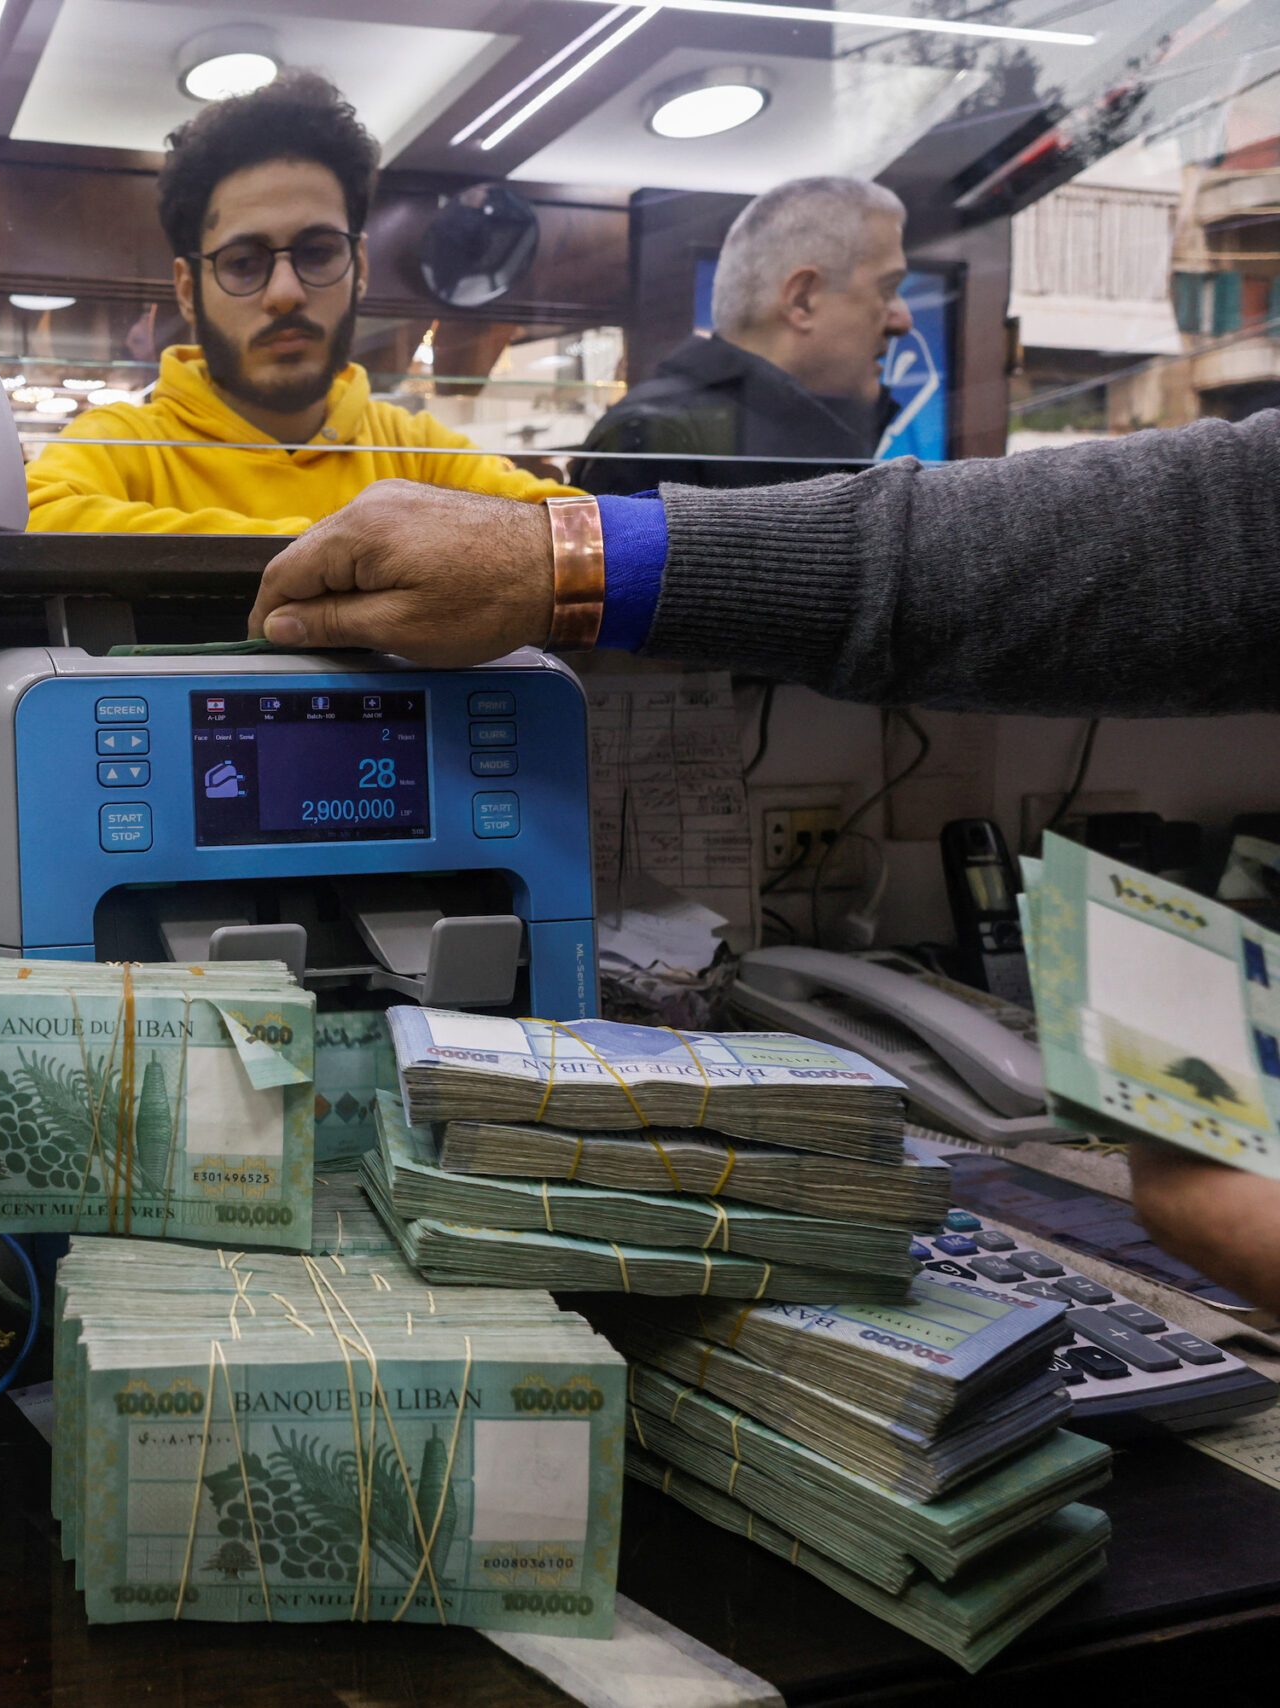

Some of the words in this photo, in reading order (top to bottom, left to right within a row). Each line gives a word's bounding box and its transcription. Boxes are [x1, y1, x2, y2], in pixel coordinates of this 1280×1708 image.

[99, 705, 145, 716] SCREEN
[382, 728, 391, 742] 2
[480, 760, 511, 769] MODE
[358, 757, 397, 788] 28
[302, 799, 395, 824] 2,900,000
[480, 803, 512, 813] START
[108, 813, 143, 824] START
[483, 821, 510, 830] STOP
[111, 832, 141, 842] STOP
[90, 1019, 116, 1034] DU
[522, 1057, 602, 1077] LIBAN
[646, 1062, 766, 1078] BANQUE
[193, 1171, 271, 1184] E301496525
[1, 1203, 48, 1217] CENT
[51, 1203, 109, 1218] MILLE
[214, 1203, 295, 1230] 100,000
[858, 1328, 954, 1366] 50,000
[113, 1390, 206, 1418] 100,000
[234, 1389, 353, 1416] BANQUE
[397, 1387, 483, 1412] LIBAN
[509, 1387, 605, 1415] 100,000
[502, 1593, 595, 1617] 100,000
